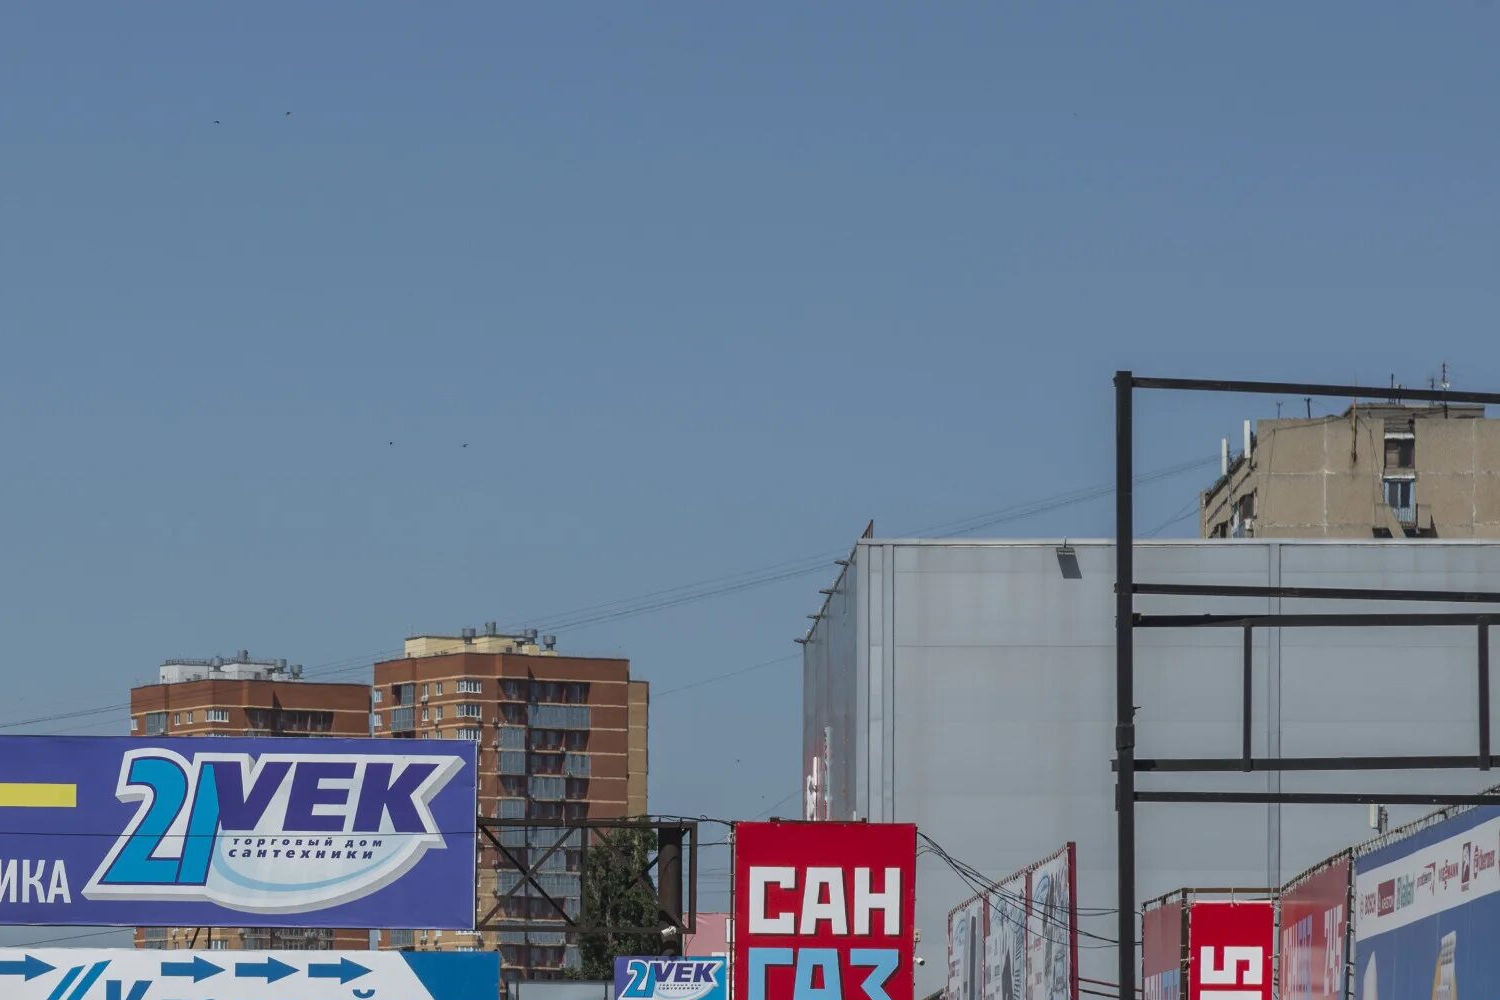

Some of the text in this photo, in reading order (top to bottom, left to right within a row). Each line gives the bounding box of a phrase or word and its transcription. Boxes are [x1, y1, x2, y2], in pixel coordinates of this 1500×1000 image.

[233, 836, 384, 849] торговый дом
[228, 846, 375, 861] сантехники
[749, 866, 901, 936] САН
